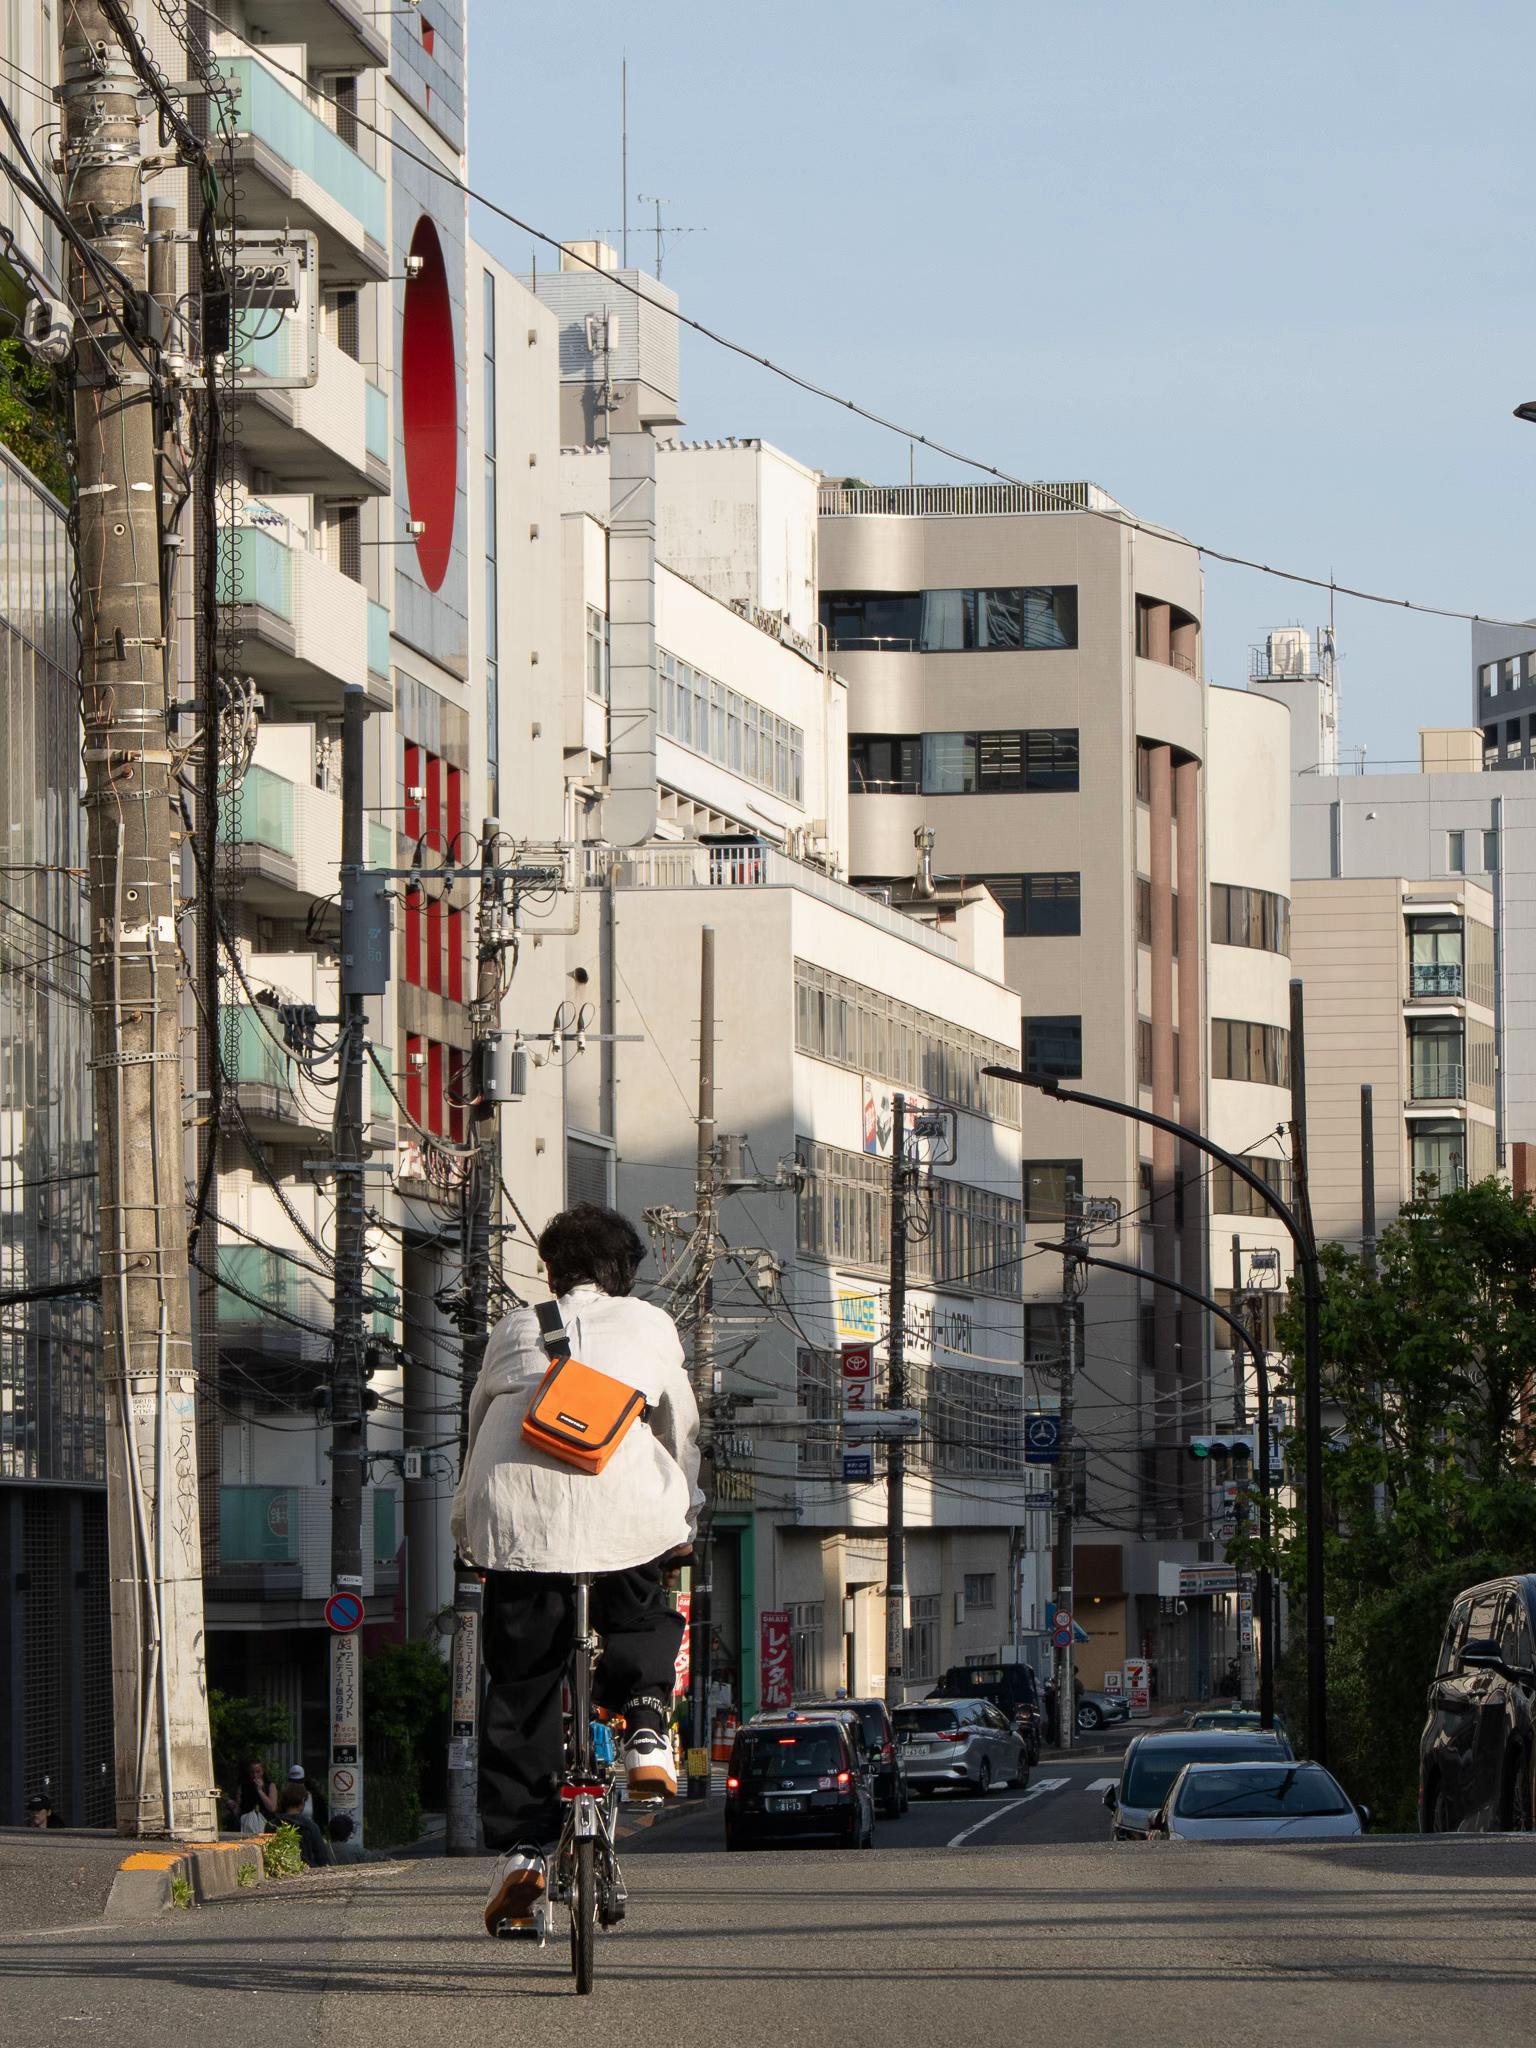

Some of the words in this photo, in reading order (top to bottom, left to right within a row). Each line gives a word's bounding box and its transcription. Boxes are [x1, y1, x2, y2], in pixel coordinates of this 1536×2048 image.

[839, 1295, 875, 1333] YANASE
[766, 1627, 788, 1704] レンタル
[633, 1737, 658, 1745] Reebok
